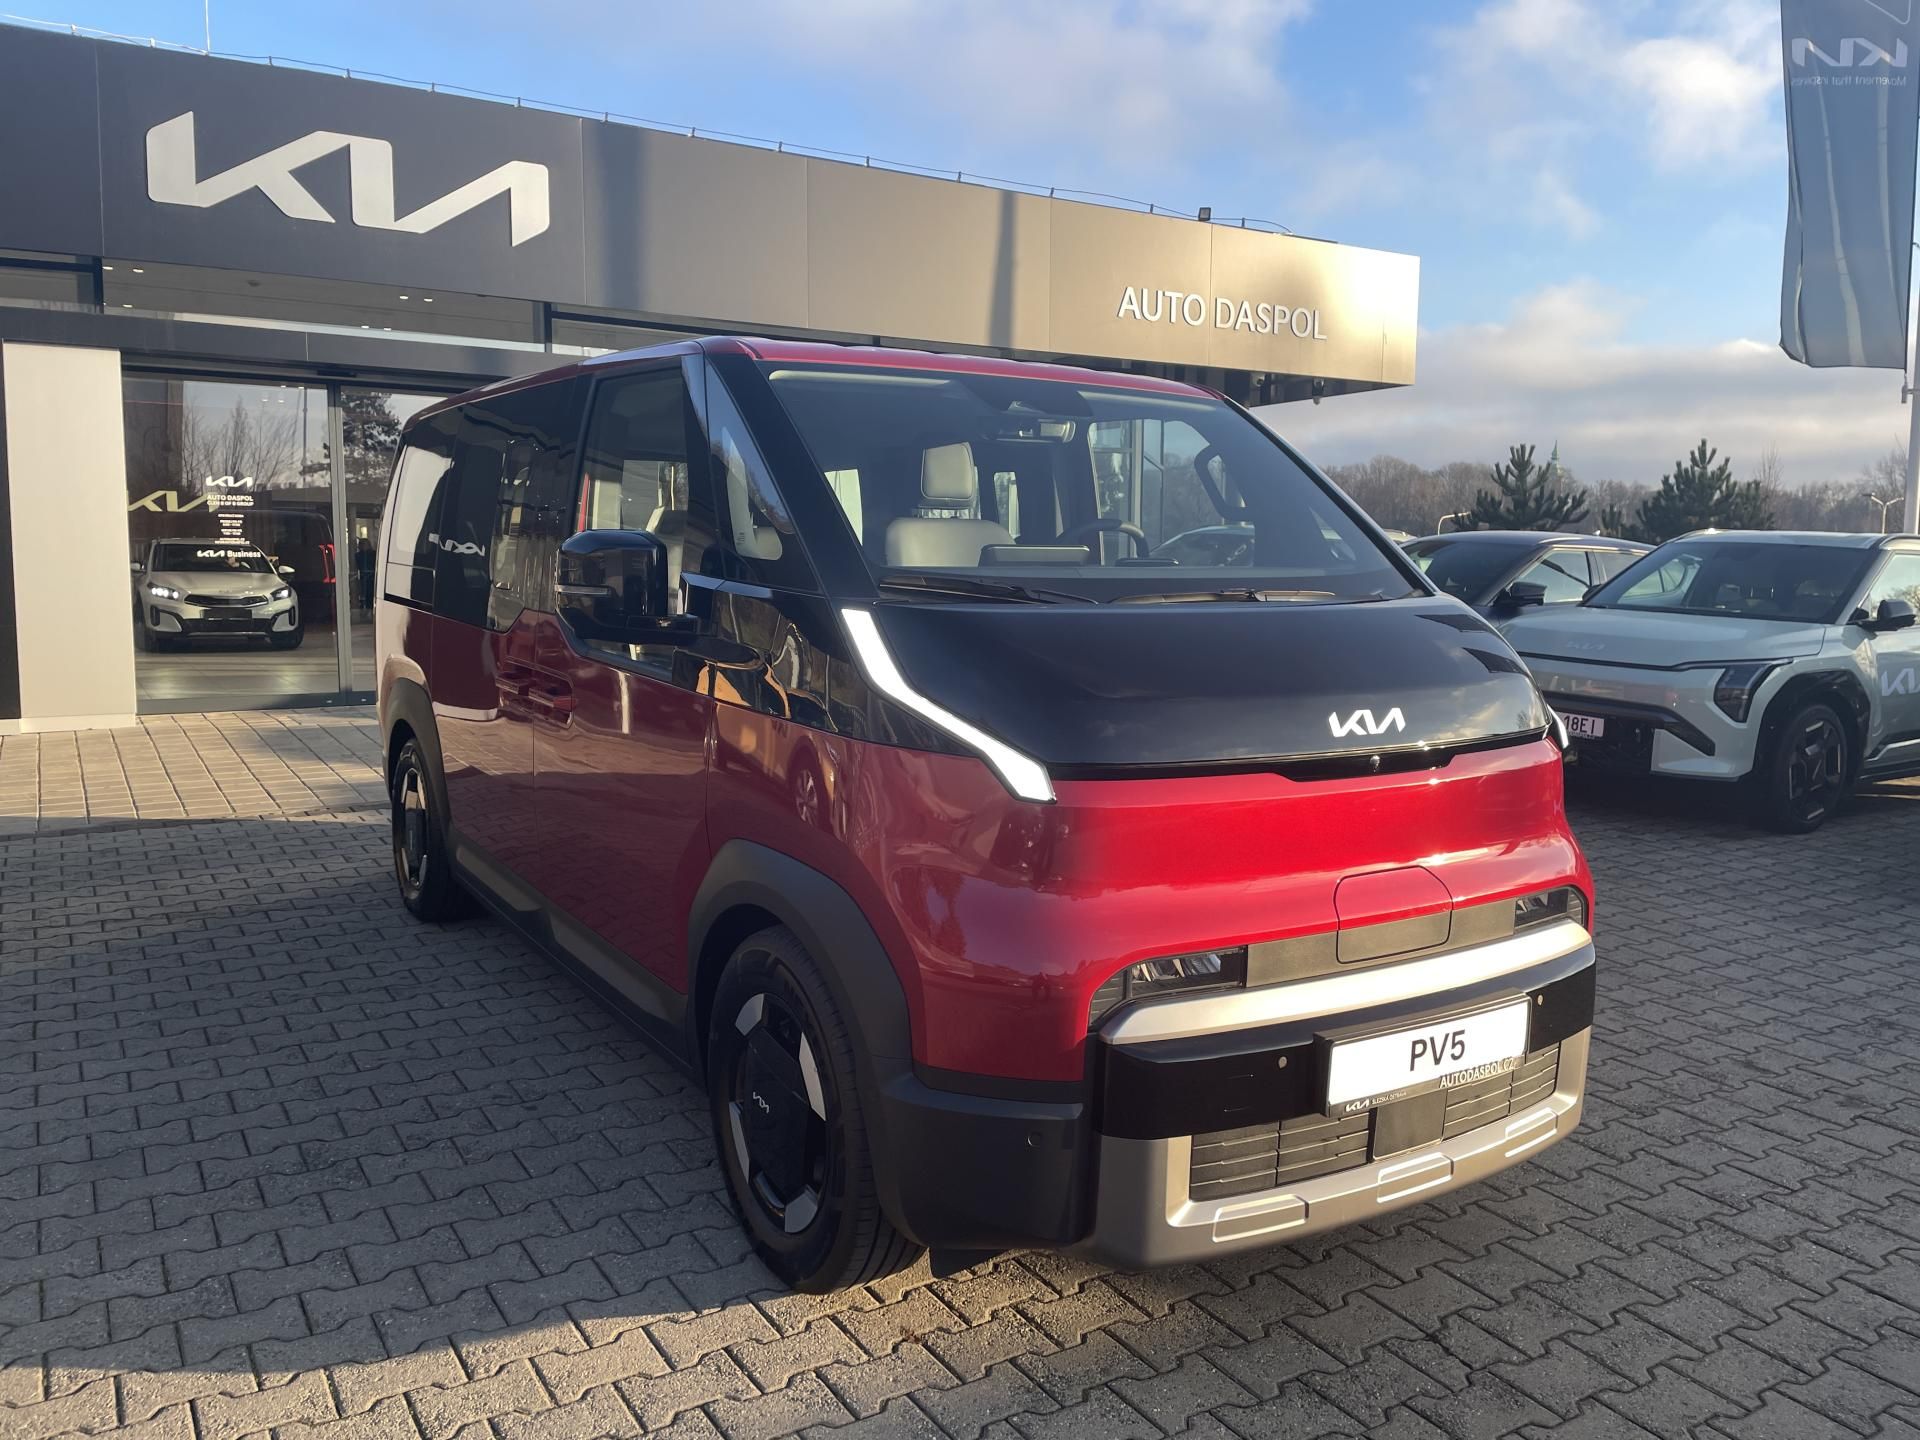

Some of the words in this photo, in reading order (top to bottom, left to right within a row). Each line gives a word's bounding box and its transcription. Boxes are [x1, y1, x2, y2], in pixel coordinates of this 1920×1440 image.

[146, 111, 549, 247] KIA
[1117, 286, 1207, 327] AUTO
[1214, 297, 1328, 341] DASPOL
[205, 475, 254, 488] KIA
[196, 549, 226, 558] KIA
[226, 549, 262, 558] Business
[1328, 706, 1407, 738] KIA
[1409, 1029, 1466, 1072] PV5
[1345, 1098, 1370, 1113] KIA
